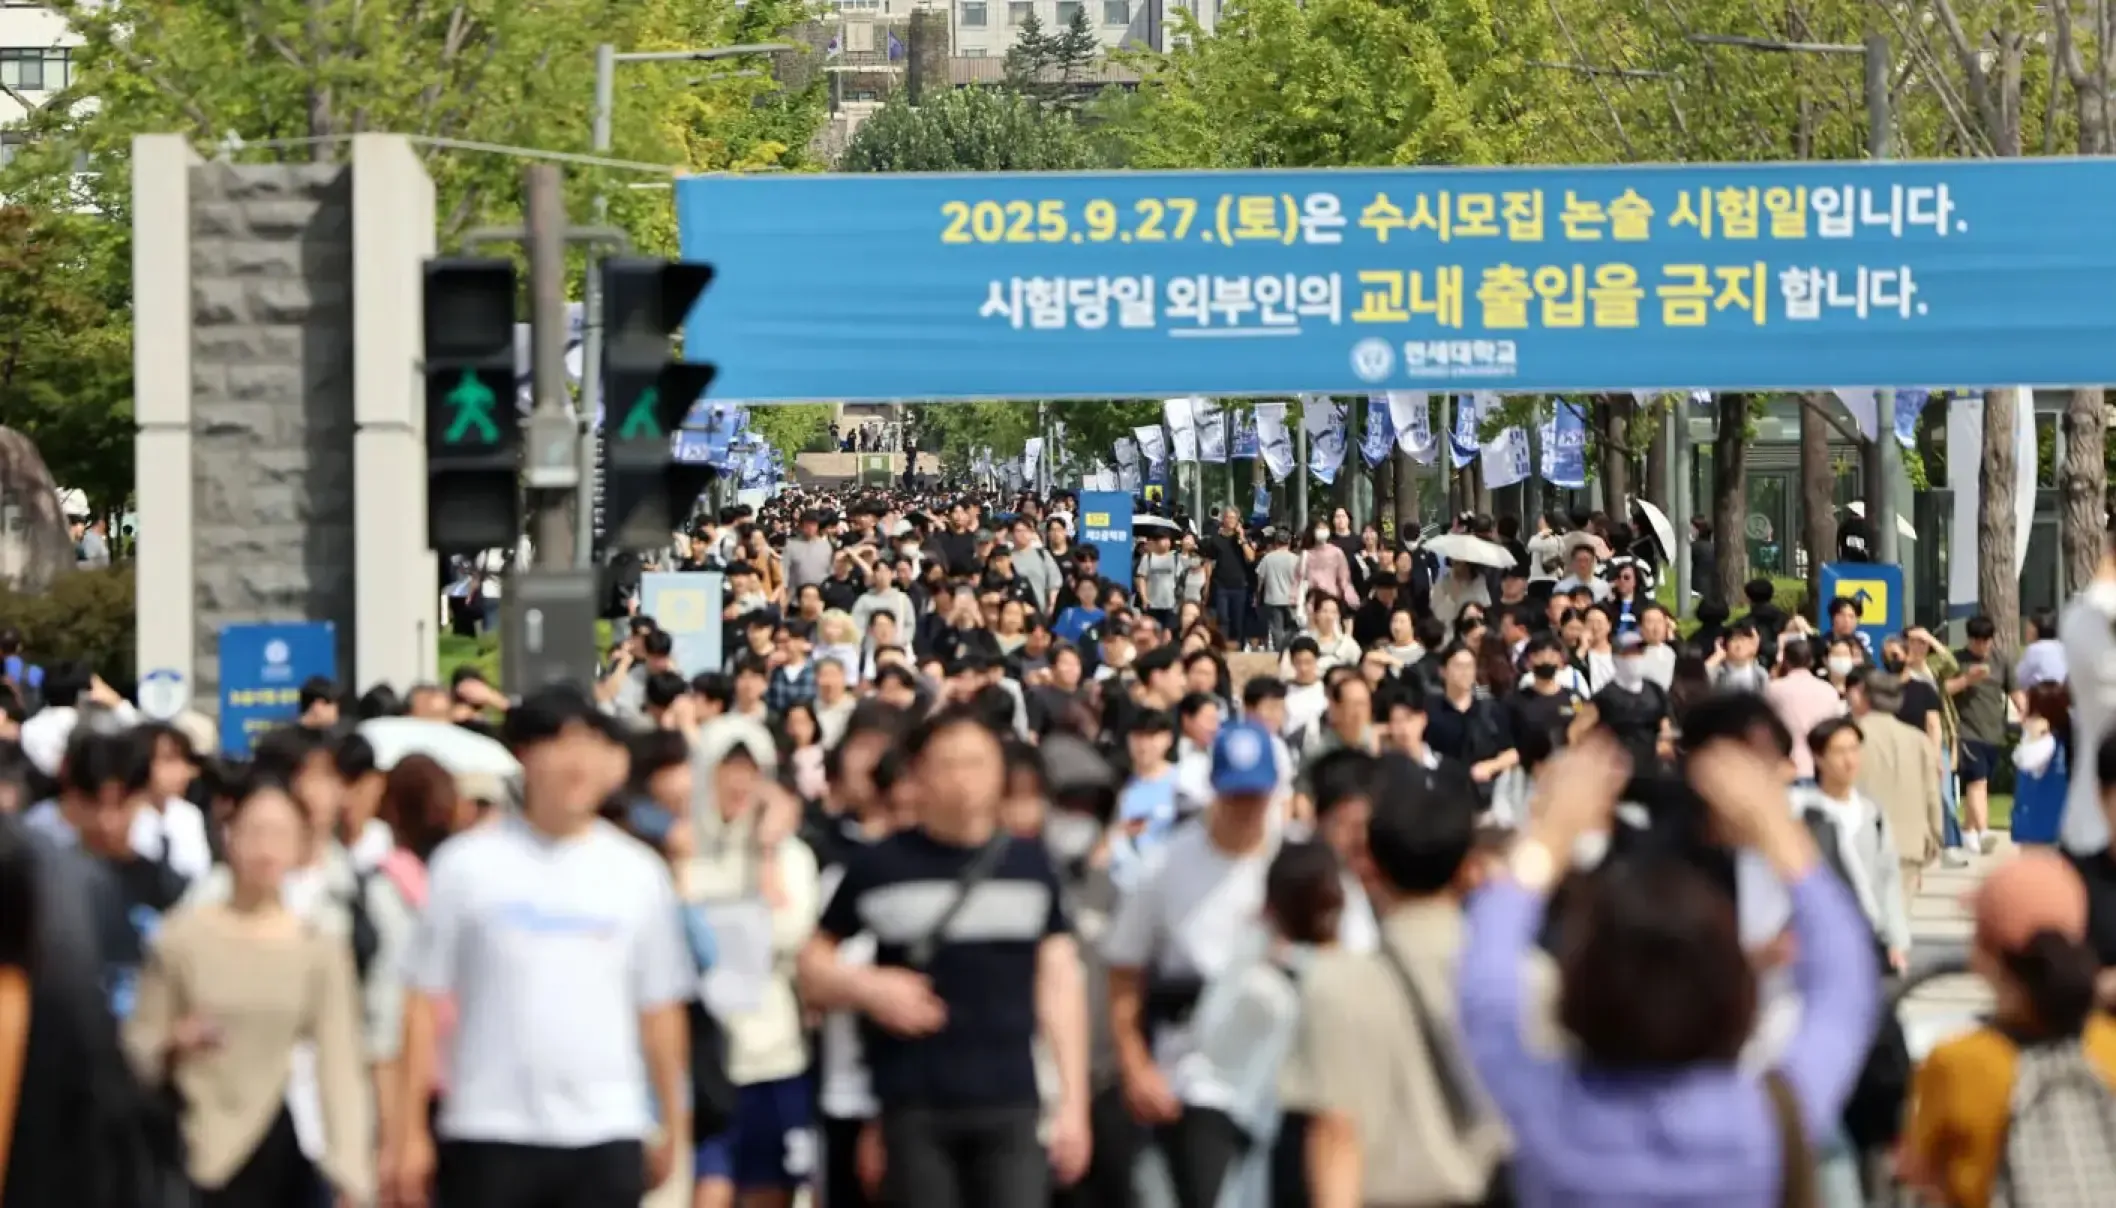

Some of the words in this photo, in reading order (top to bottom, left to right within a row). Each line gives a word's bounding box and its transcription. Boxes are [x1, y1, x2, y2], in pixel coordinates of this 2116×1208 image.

[940, 192, 1347, 246] 2025.9.27.(토)은
[1358, 188, 1544, 243] 수시모집
[1559, 188, 1655, 241] 논술
[1667, 183, 1968, 239] 시험일입니다.
[979, 276, 1156, 330] 시험당일
[1165, 272, 1342, 328] 외부인의
[1351, 264, 1464, 329] 교내
[1475, 263, 1645, 329] 출입을
[1655, 260, 1767, 327] 금지
[1779, 265, 1928, 320] 합니다.
